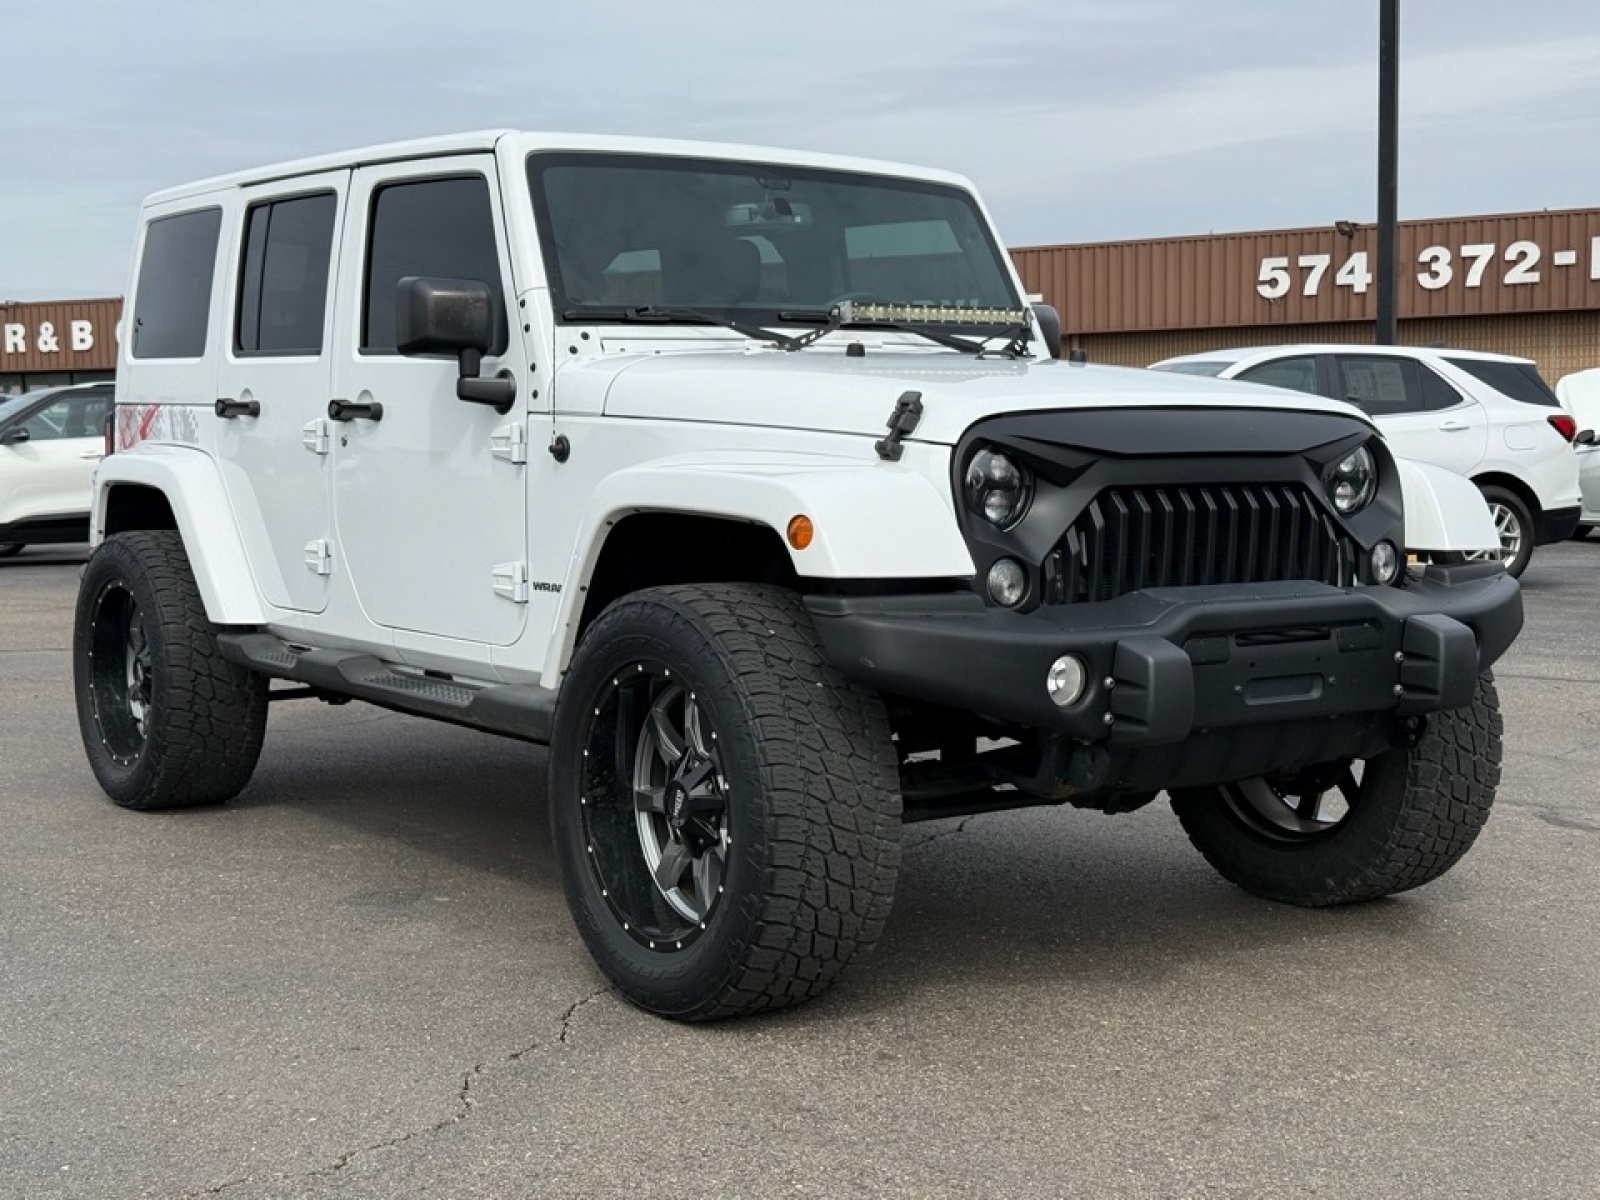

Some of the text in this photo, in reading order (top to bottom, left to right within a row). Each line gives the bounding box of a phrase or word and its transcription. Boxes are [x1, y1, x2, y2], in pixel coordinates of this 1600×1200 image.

[1256, 236, 1600, 299] 574 372-
[4, 323, 26, 353] R
[37, 321, 60, 352] &
[71, 319, 94, 351] B
